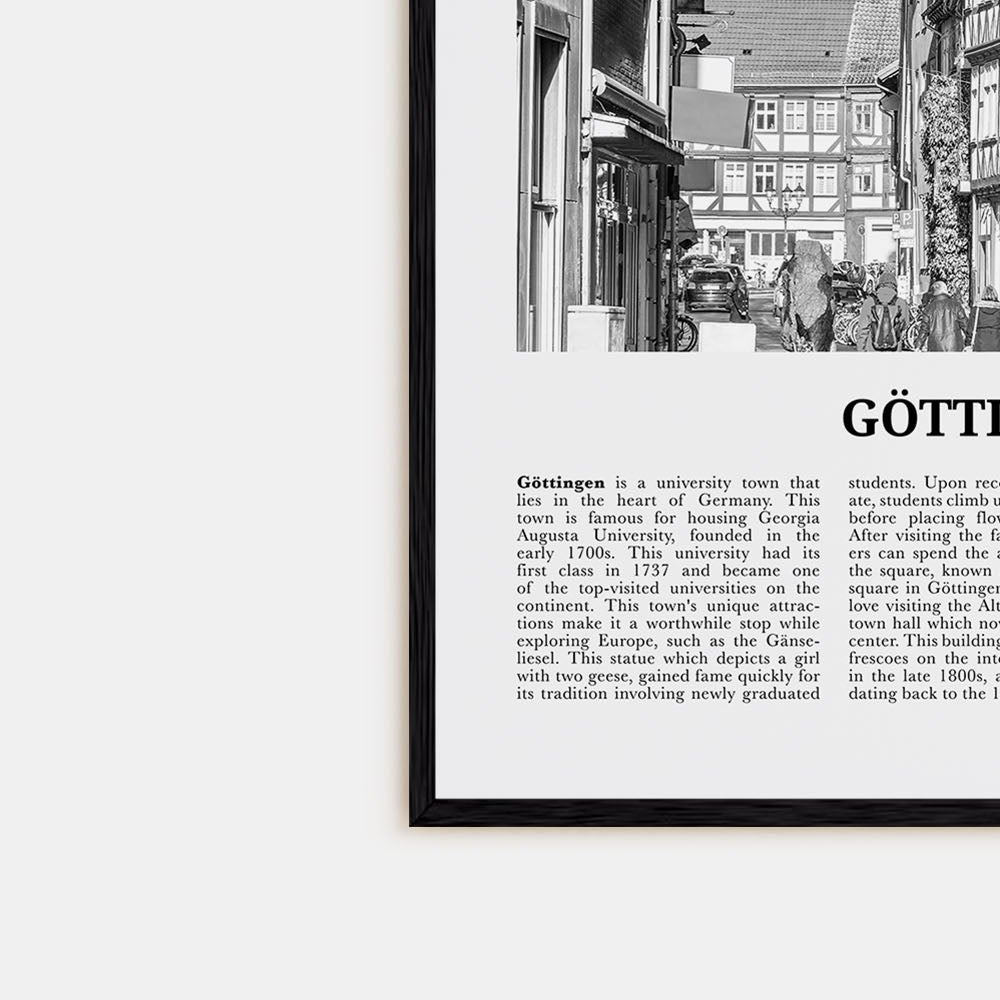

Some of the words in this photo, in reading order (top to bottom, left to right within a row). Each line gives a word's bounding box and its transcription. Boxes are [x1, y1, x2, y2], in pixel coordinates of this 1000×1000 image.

[516, 475, 606, 493] Göttingen
[615, 475, 628, 489] is
[637, 479, 647, 489] a
[656, 475, 732, 493] university
[742, 478, 780, 489] town
[789, 475, 821, 489] that
[848, 475, 916, 489] students.
[925, 475, 968, 493] Upon
[516, 492, 542, 507] lies
[553, 493, 569, 507] in
[580, 492, 605, 507] the
[616, 492, 657, 507] heart
[668, 492, 686, 507] of
[698, 492, 773, 511] Germany.
[786, 492, 821, 507] This
[848, 495, 876, 510] ate,
[879, 492, 943, 507] students
[946, 492, 990, 507] climb
[516, 513, 554, 525] town
[565, 510, 578, 525] is
[588, 510, 644, 525] famous
[654, 510, 677, 525] for
[687, 510, 748, 528] housing
[758, 510, 821, 528] Georgia
[849, 510, 897, 525] before
[908, 510, 966, 528] placing
[516, 528, 579, 546] Augusta
[594, 528, 676, 546] University,
[689, 528, 753, 542] founded
[766, 528, 782, 542] in
[796, 528, 821, 542] the
[516, 545, 555, 564] early
[569, 545, 615, 560] 1700s.
[629, 545, 663, 560] This
[674, 546, 751, 564] university
[762, 545, 791, 560] had
[802, 546, 821, 560] its
[848, 549, 871, 560] ers
[878, 549, 905, 560] can
[912, 545, 958, 564] spend
[965, 545, 989, 560] the
[516, 580, 533, 595] of
[544, 580, 569, 595] the
[578, 580, 660, 599] top-visited
[669, 581, 757, 595] universities
[766, 585, 786, 595] on
[796, 580, 820, 595] the
[848, 585, 899, 599] square
[905, 581, 921, 595] in
[516, 598, 594, 612] continent.
[605, 598, 640, 612] This
[649, 598, 697, 612] town's
[706, 598, 760, 616] unique
[769, 601, 821, 612] attrac-
[848, 598, 880, 612] love
[885, 598, 942, 616] visiting
[947, 598, 972, 612] the
[848, 618, 886, 630] town
[892, 616, 921, 630] hall
[927, 616, 973, 630] which
[848, 636, 899, 648] center.
[904, 633, 939, 648] This
[516, 686, 535, 700] its
[540, 686, 608, 700] tradition
[614, 686, 686, 704] involving
[691, 686, 736, 704] newly
[742, 686, 821, 704] graduated
